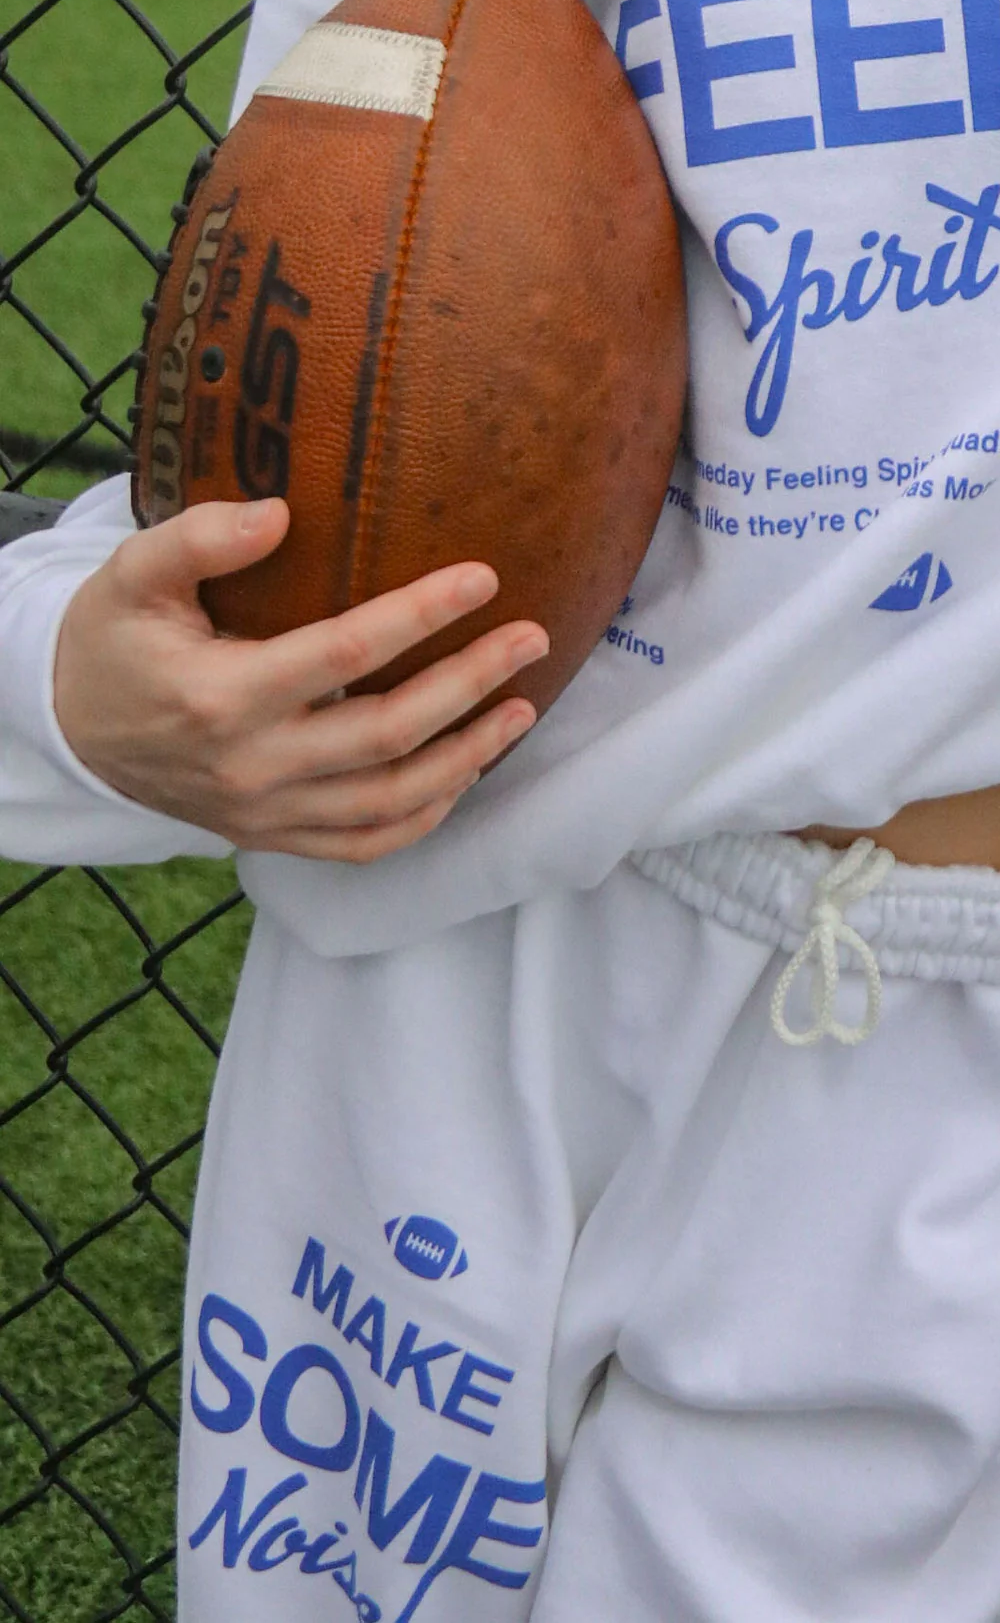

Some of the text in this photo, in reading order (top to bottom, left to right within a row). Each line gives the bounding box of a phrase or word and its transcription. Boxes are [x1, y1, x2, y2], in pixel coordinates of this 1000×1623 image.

[234, 236, 312, 501] GST
[705, 504, 740, 536] like
[748, 508, 846, 539] they're
[766, 464, 868, 490] Feeling
[291, 1235, 516, 1437] MAKE
[190, 1292, 547, 1590] SOME
